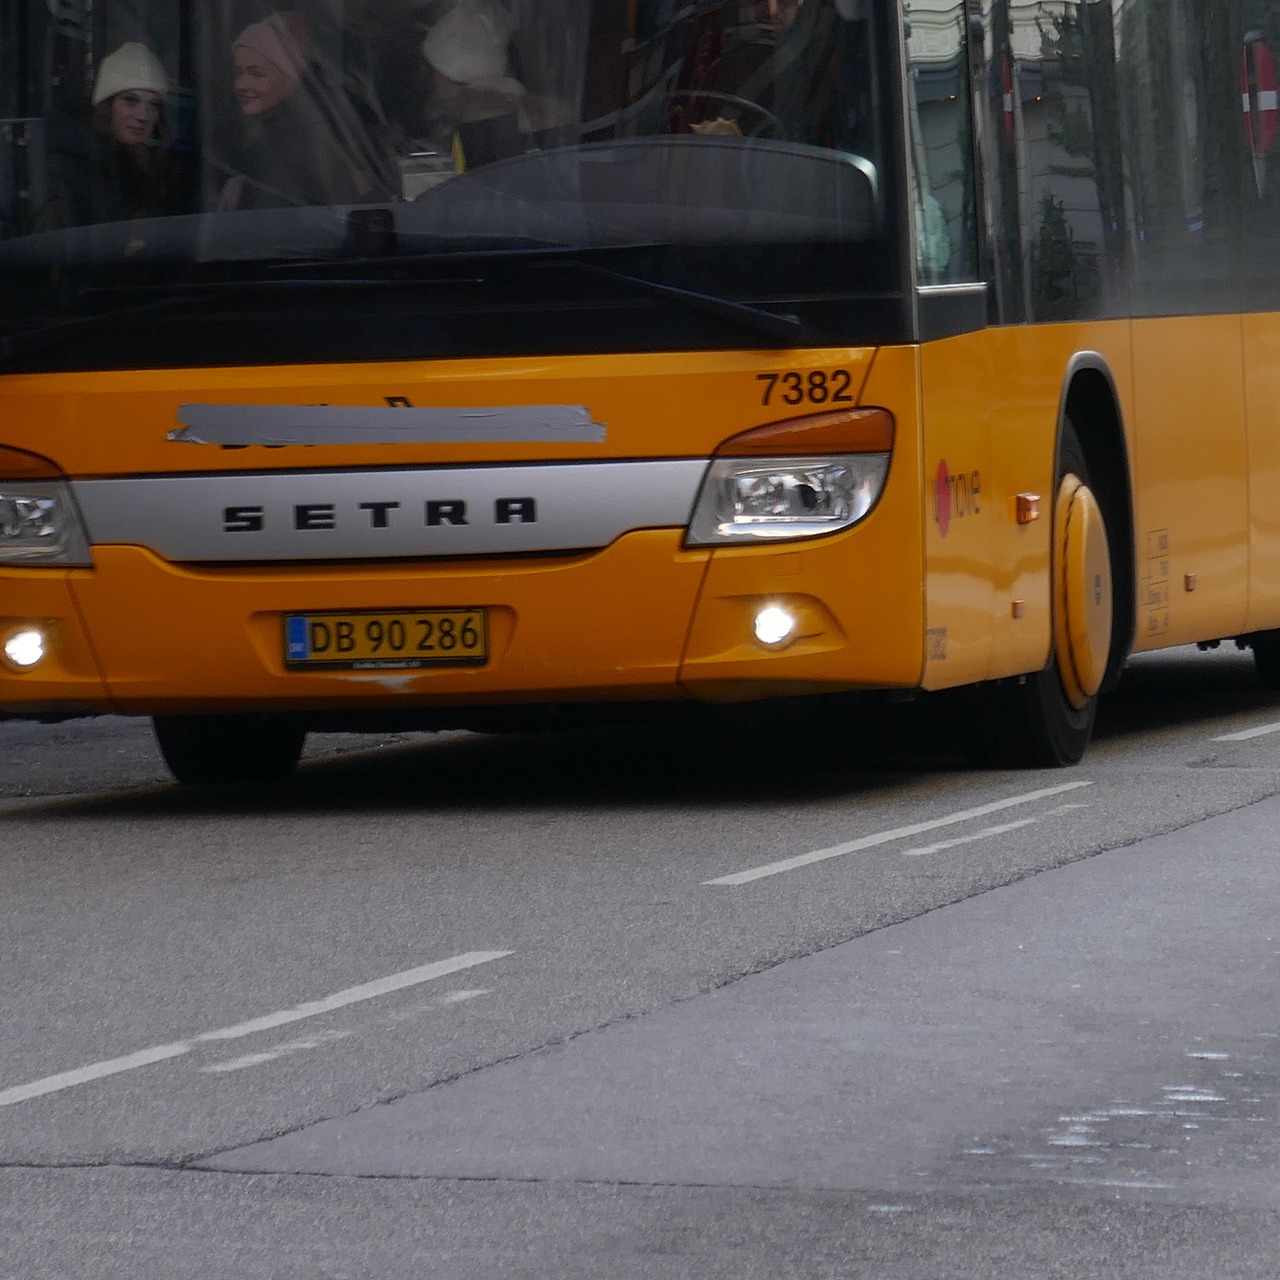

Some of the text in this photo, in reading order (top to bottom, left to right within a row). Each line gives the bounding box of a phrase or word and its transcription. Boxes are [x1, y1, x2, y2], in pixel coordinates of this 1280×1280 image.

[757, 370, 852, 406] 7382
[223, 496, 538, 532] SETRA
[311, 618, 478, 652] DB 90 286
